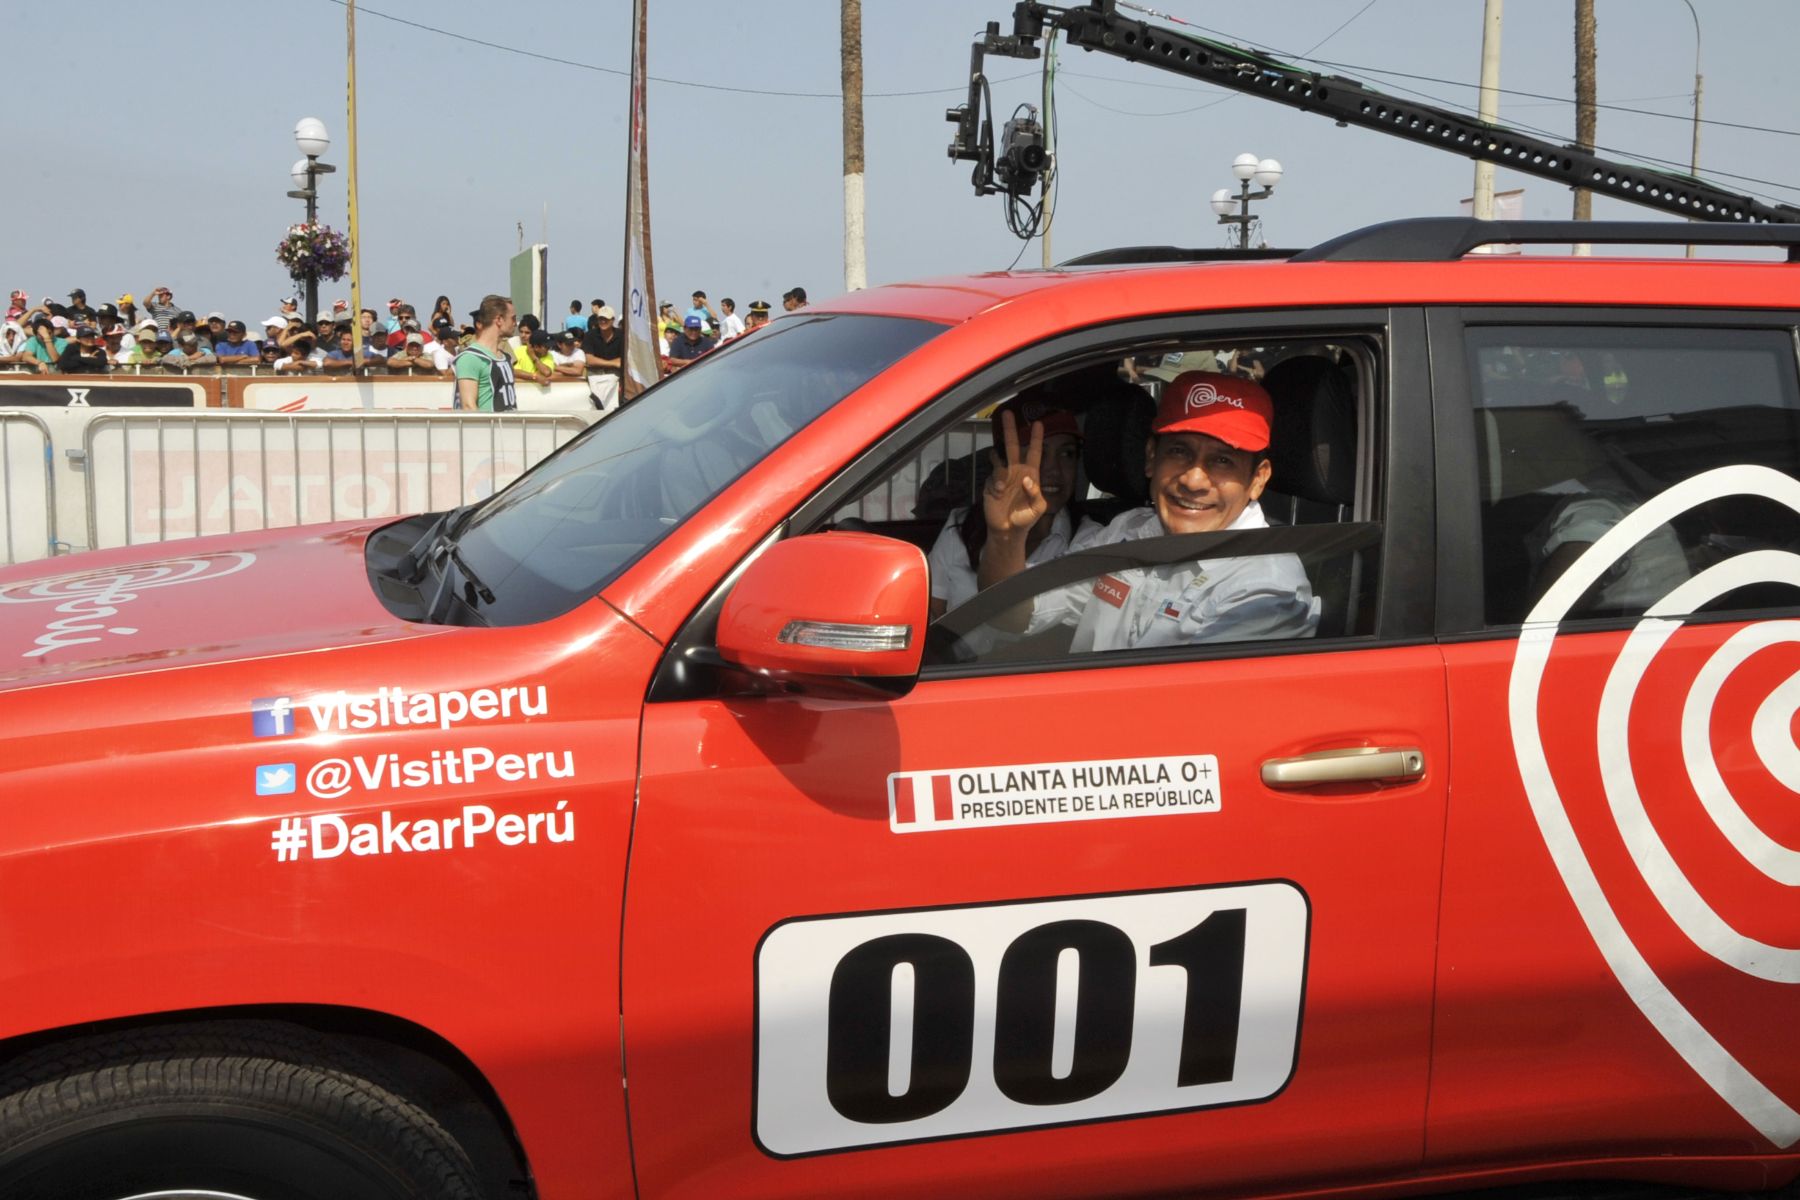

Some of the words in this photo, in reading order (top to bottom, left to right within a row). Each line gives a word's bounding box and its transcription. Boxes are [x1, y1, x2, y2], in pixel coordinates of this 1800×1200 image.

[307, 685, 548, 731] visitaperu
[306, 747, 575, 799] @VisitPeru
[958, 769, 1067, 795] OLLANTA
[1072, 763, 1171, 789] HUMALA
[1181, 761, 1212, 783] O+
[960, 796, 1068, 819] PRESIDENTE
[1072, 795, 1095, 812] DE
[1099, 794, 1119, 811] LA
[1123, 787, 1215, 809] REPÚBLICA
[271, 800, 575, 862] #DakarPerú
[826, 907, 1248, 1125] 001
